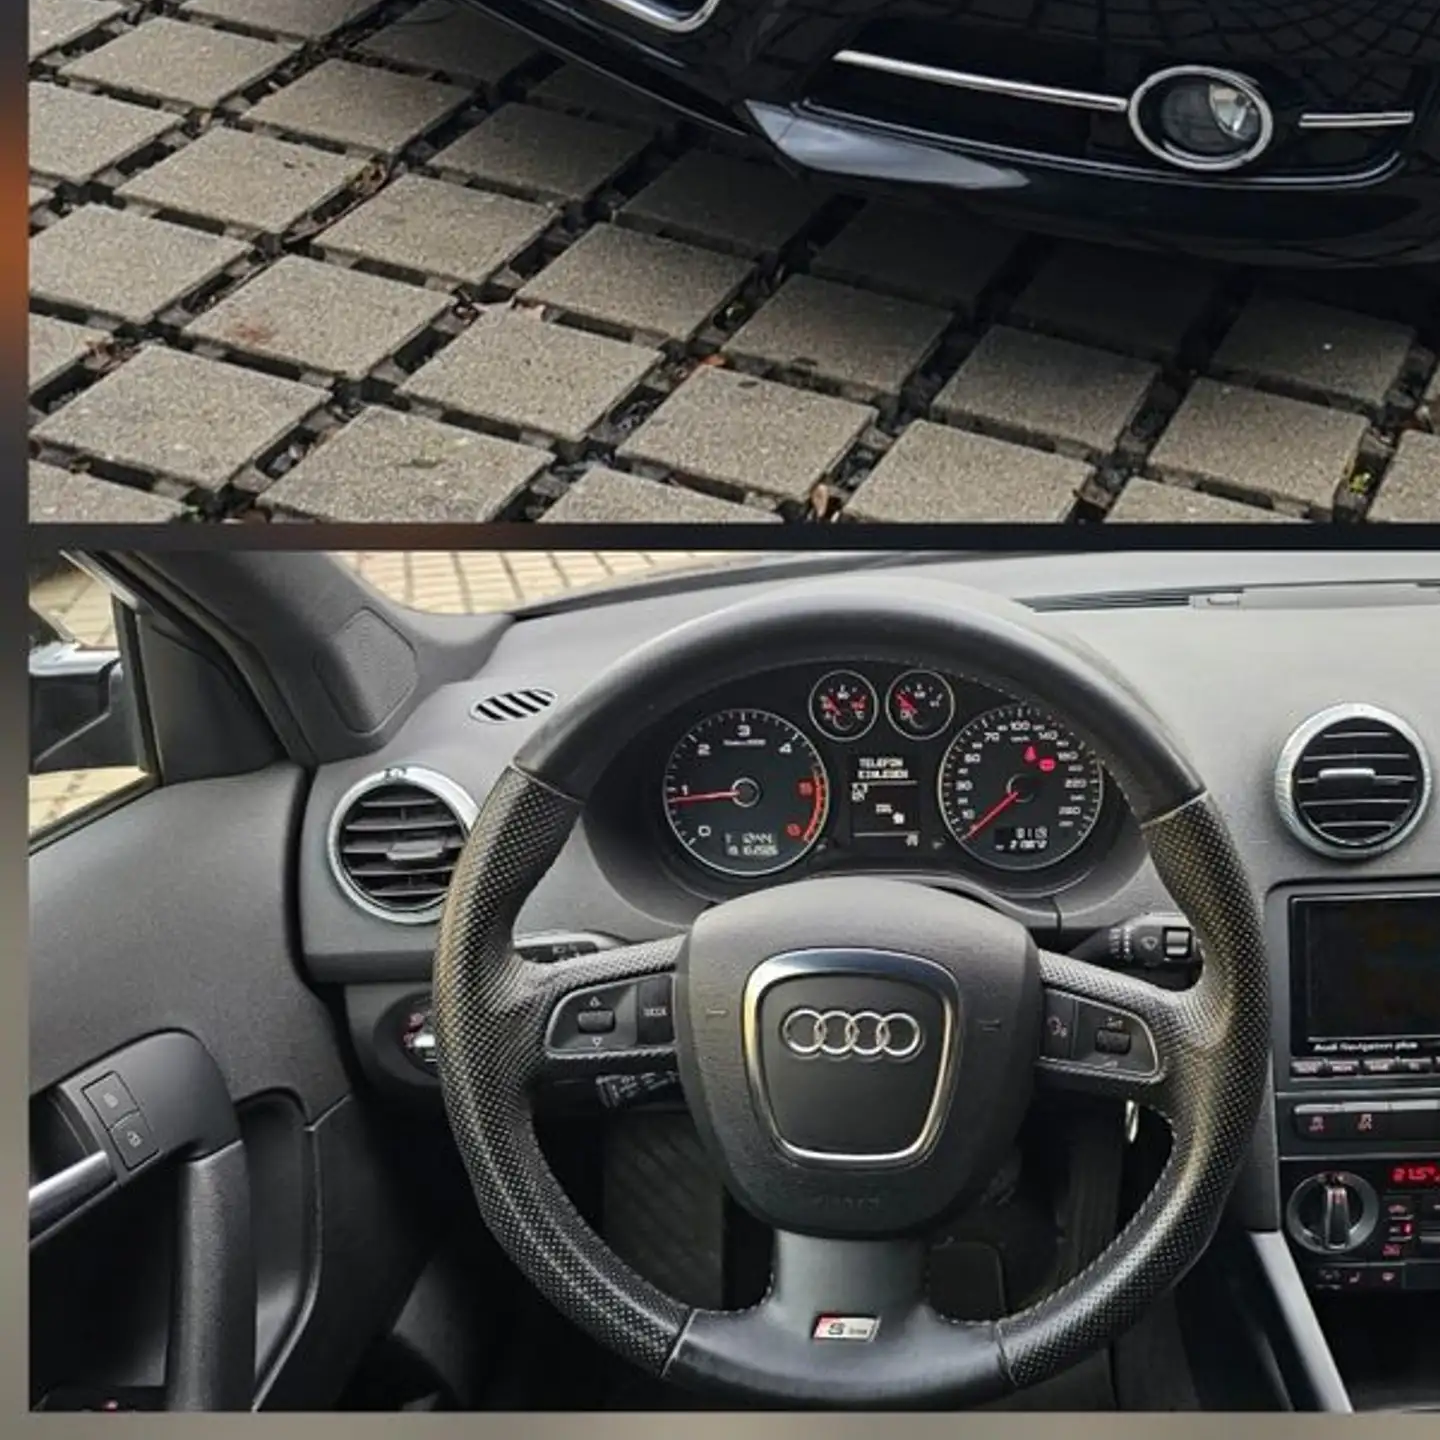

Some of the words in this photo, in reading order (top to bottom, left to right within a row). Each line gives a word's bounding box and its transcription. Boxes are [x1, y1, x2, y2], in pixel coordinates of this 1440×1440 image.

[736, 724, 752, 737] 3
[697, 743, 712, 756] 2
[778, 743, 792, 754] 4
[697, 824, 712, 838] 0
